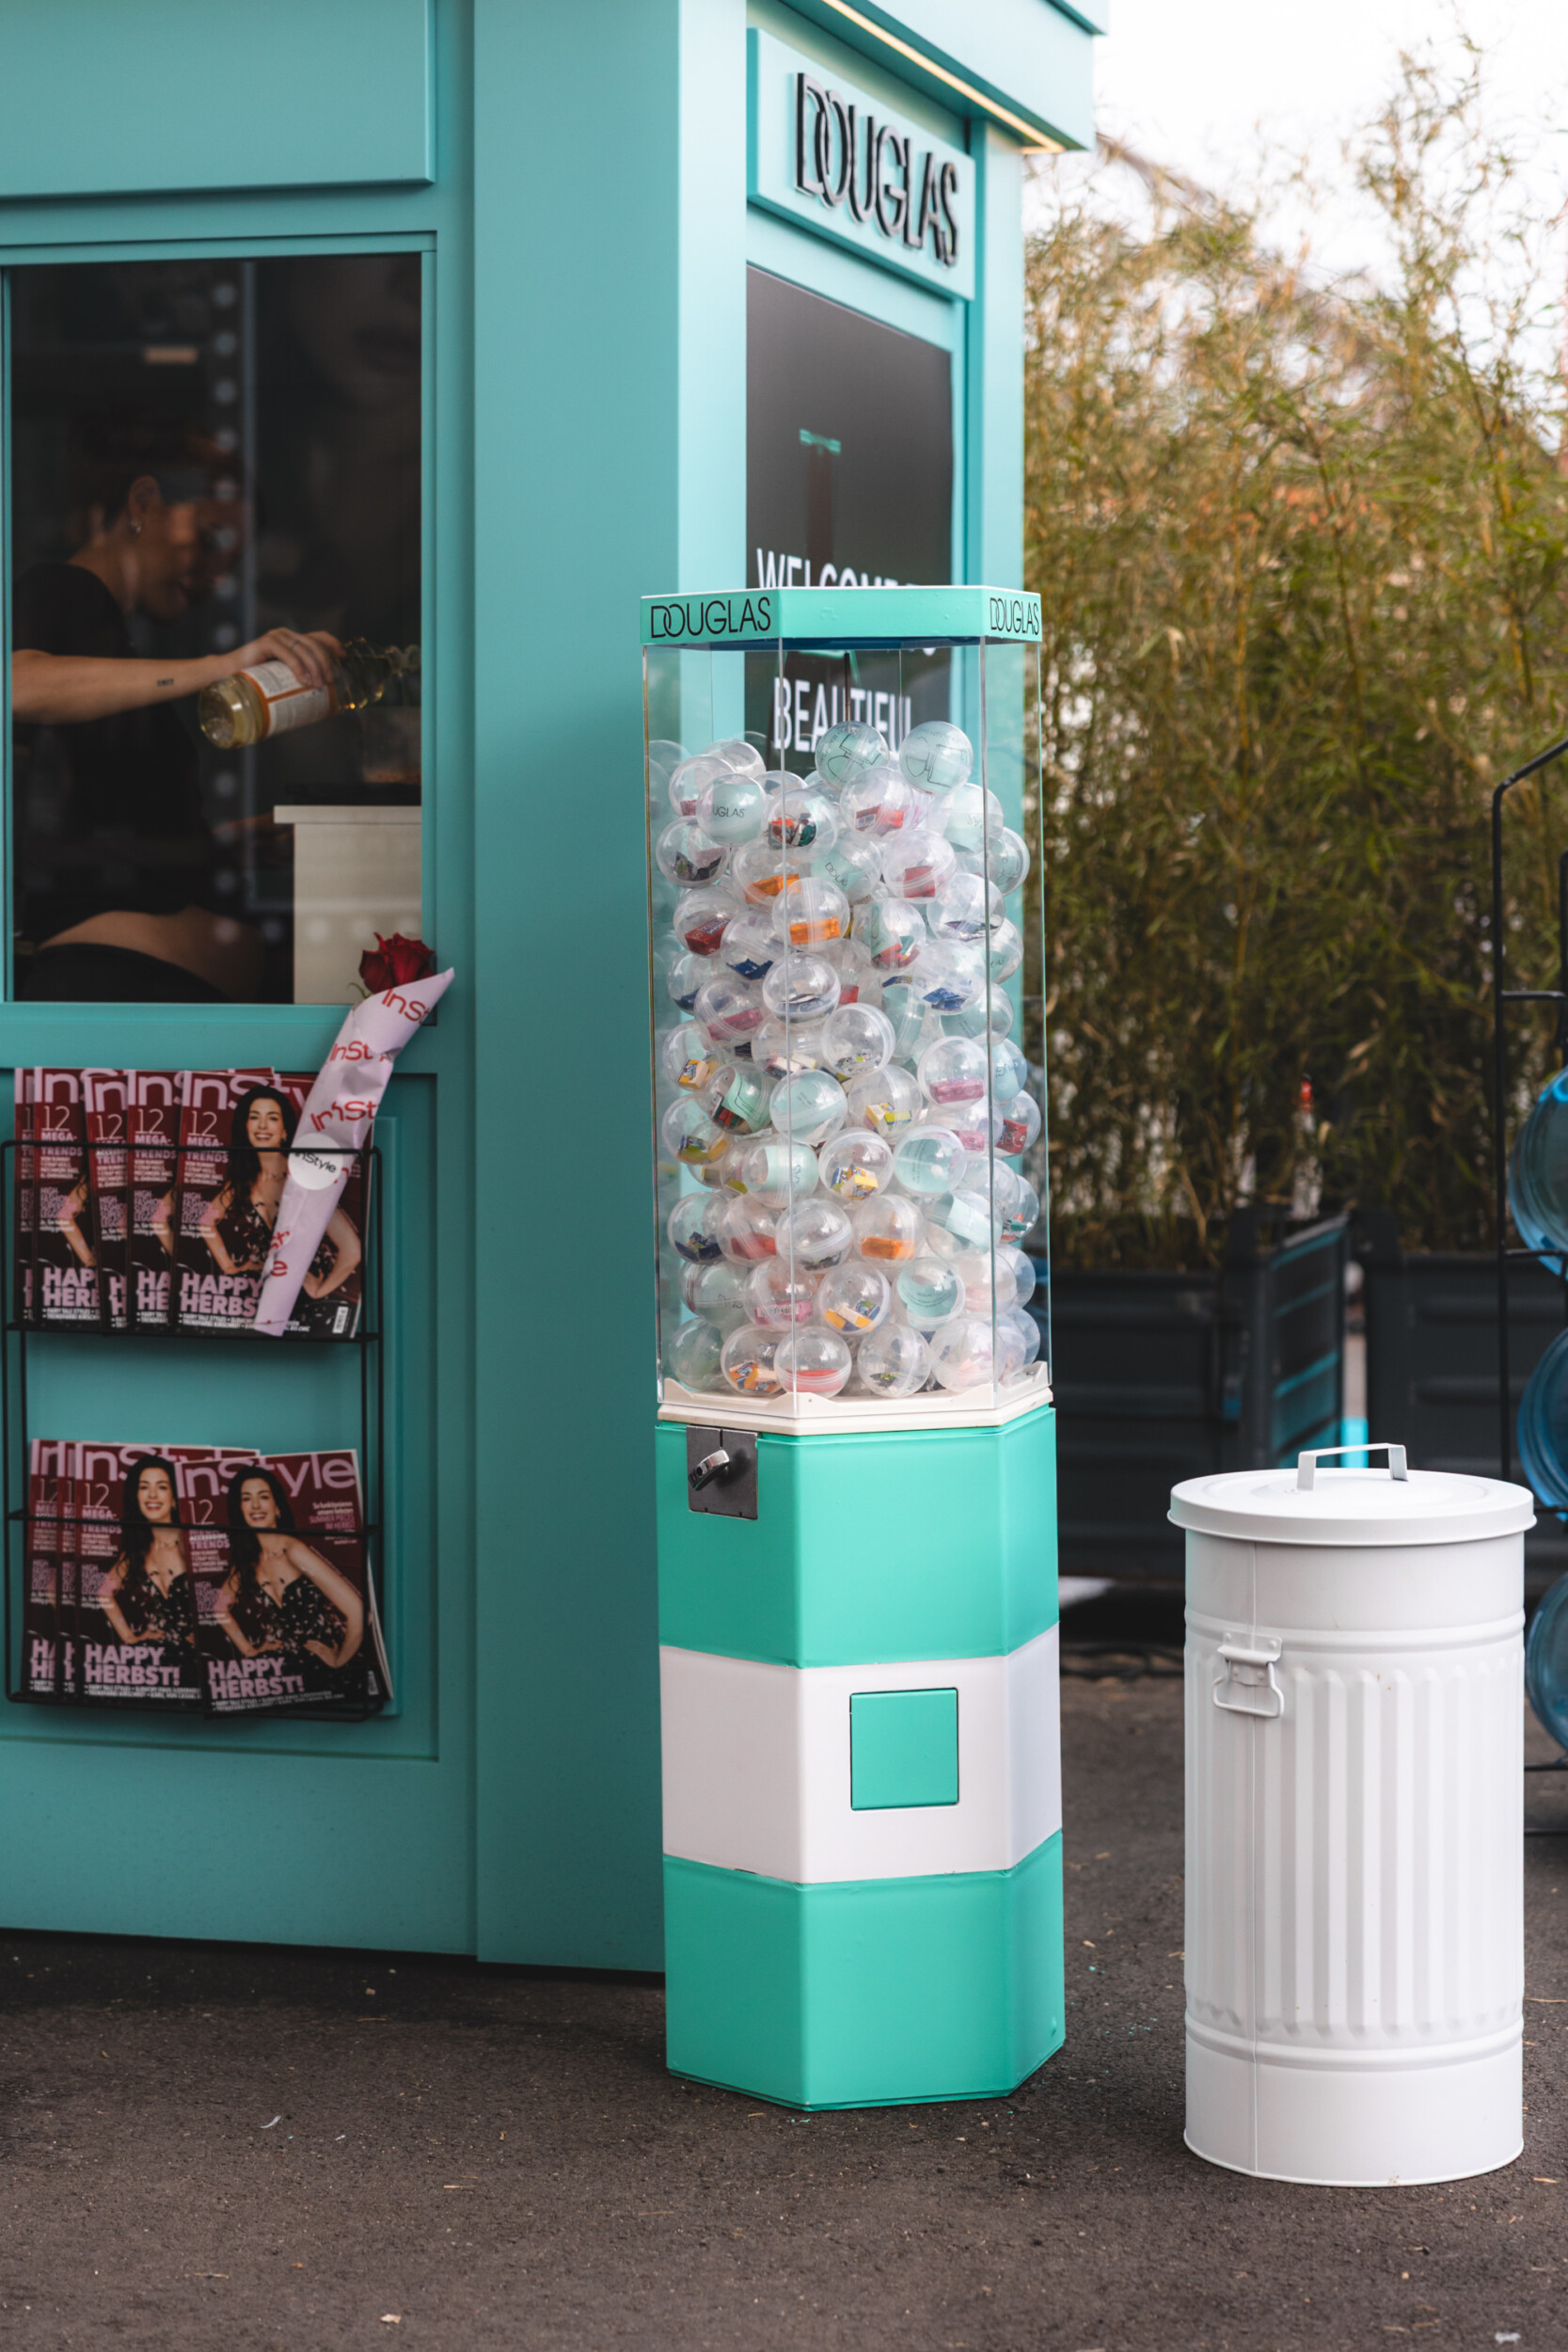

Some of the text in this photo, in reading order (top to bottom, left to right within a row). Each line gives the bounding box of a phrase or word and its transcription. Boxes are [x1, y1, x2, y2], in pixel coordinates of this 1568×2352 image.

[795, 72, 958, 268] DOUGLAS
[650, 596, 771, 640] DOUGLAS
[989, 596, 1040, 636] DOUGLAS
[381, 987, 430, 1025] InS
[43, 1105, 71, 1131] 12
[96, 1114, 123, 1140] 12
[136, 1108, 164, 1134] 12
[188, 1110, 216, 1137] 12
[182, 1273, 264, 1301] HAPPY
[180, 1294, 261, 1316] HERBS
[84, 1483, 110, 1509] 12
[188, 1499, 215, 1525] 12
[190, 1539, 230, 1550] TRENDS
[85, 1644, 165, 1665] HAPPY
[84, 1663, 181, 1686] HERBST!
[208, 1657, 285, 1681] HAPPY
[208, 1675, 306, 1700] HERBST!
